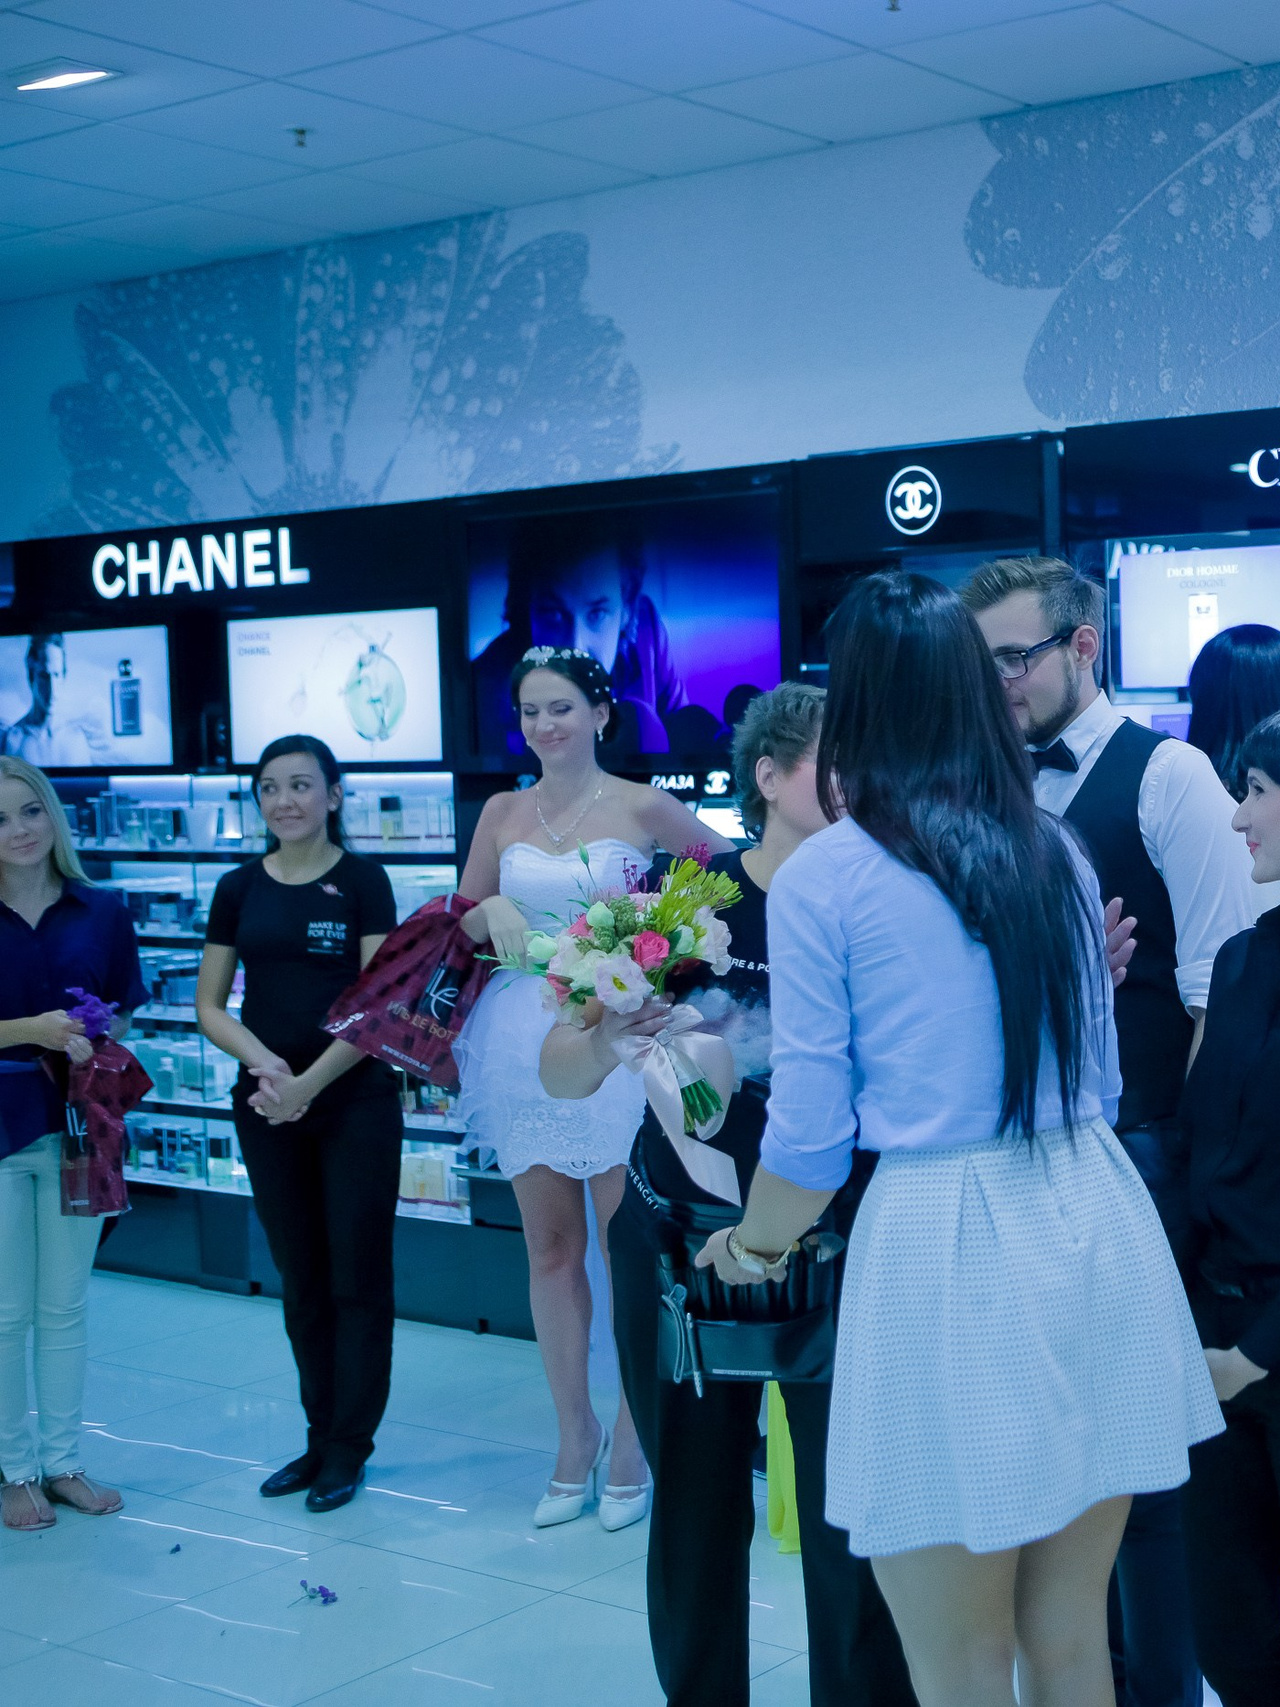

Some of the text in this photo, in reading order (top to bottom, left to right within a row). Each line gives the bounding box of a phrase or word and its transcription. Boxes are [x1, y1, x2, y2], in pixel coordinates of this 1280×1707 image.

[92, 527, 311, 599] CHANEL
[1166, 564, 1240, 579] DIOR HOMME
[651, 774, 695, 790] ГЛАЗА
[309, 921, 348, 931] MAKE UP
[307, 929, 347, 940] FOR EVER
